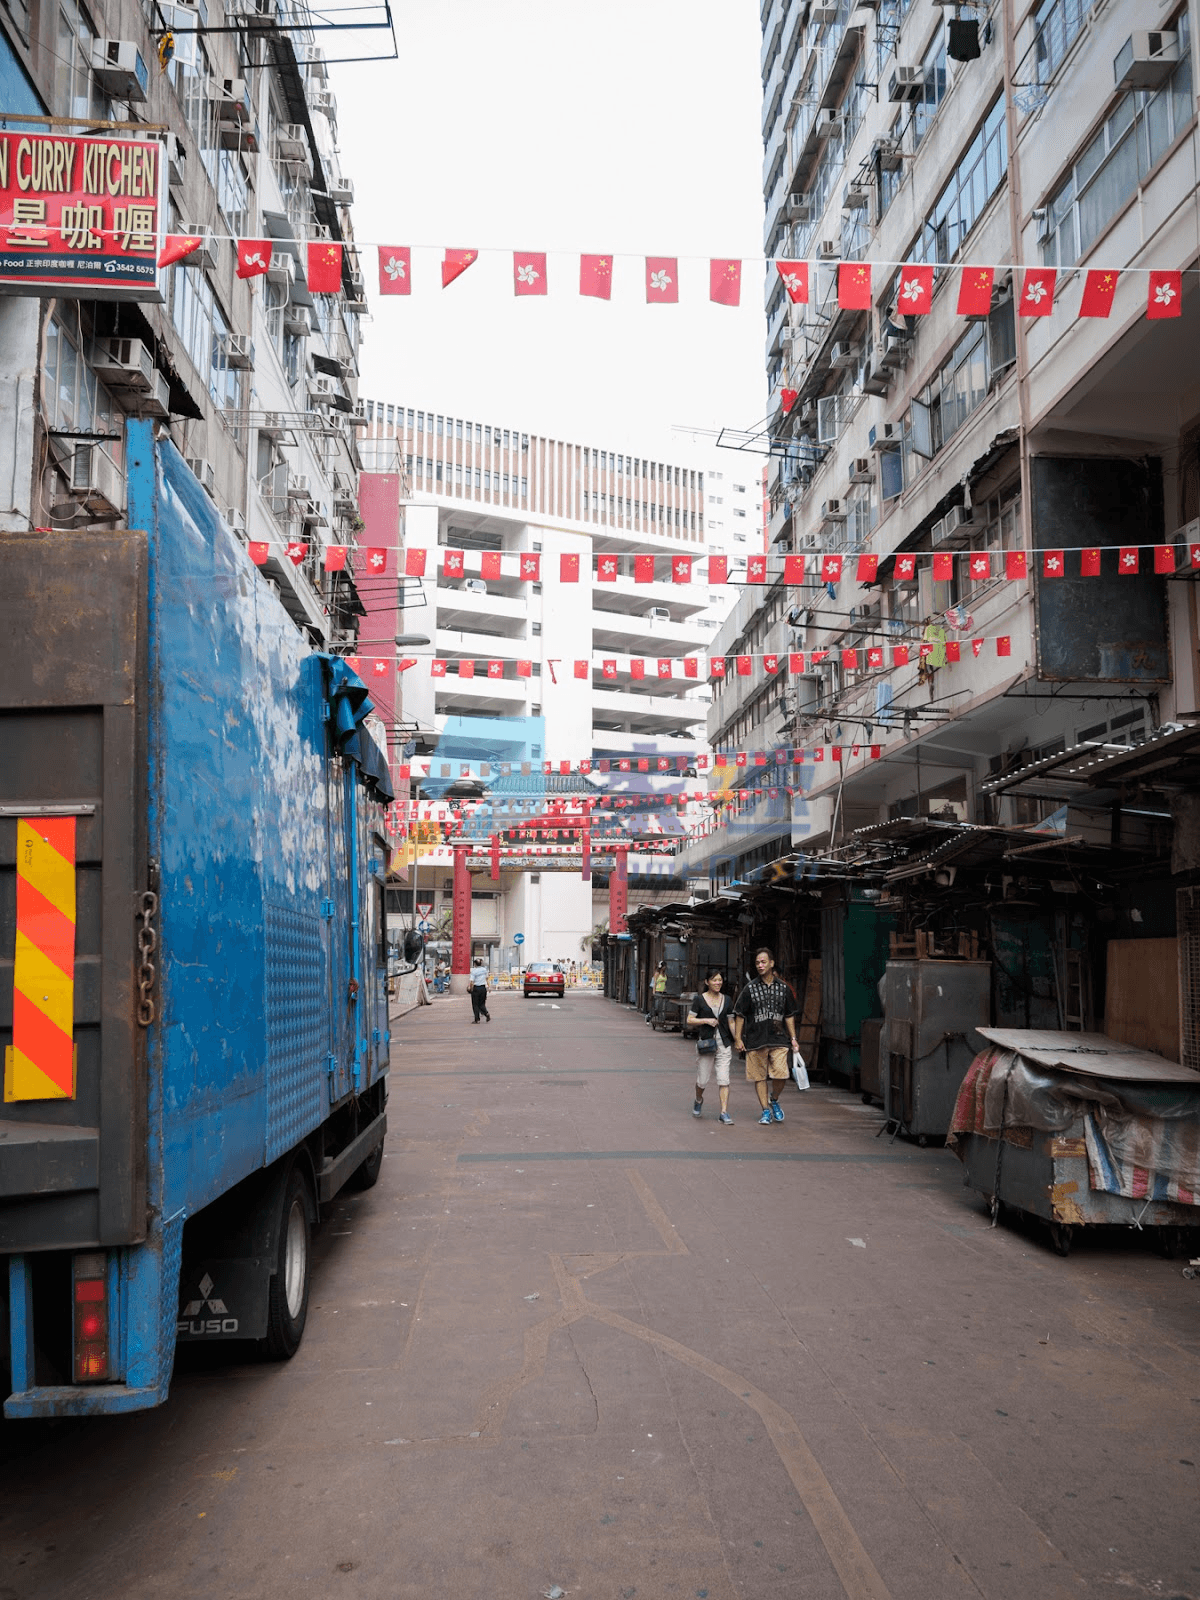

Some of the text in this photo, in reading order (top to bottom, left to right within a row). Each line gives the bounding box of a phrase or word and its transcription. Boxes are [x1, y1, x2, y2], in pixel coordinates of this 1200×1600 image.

[17, 138, 75, 192] CURRY
[83, 143, 155, 197] KITCHEN
[3, 259, 24, 268] Food
[116, 263, 135, 273] 3542
[136, 265, 155, 275] 5575
[177, 1318, 239, 1335] FUSO
